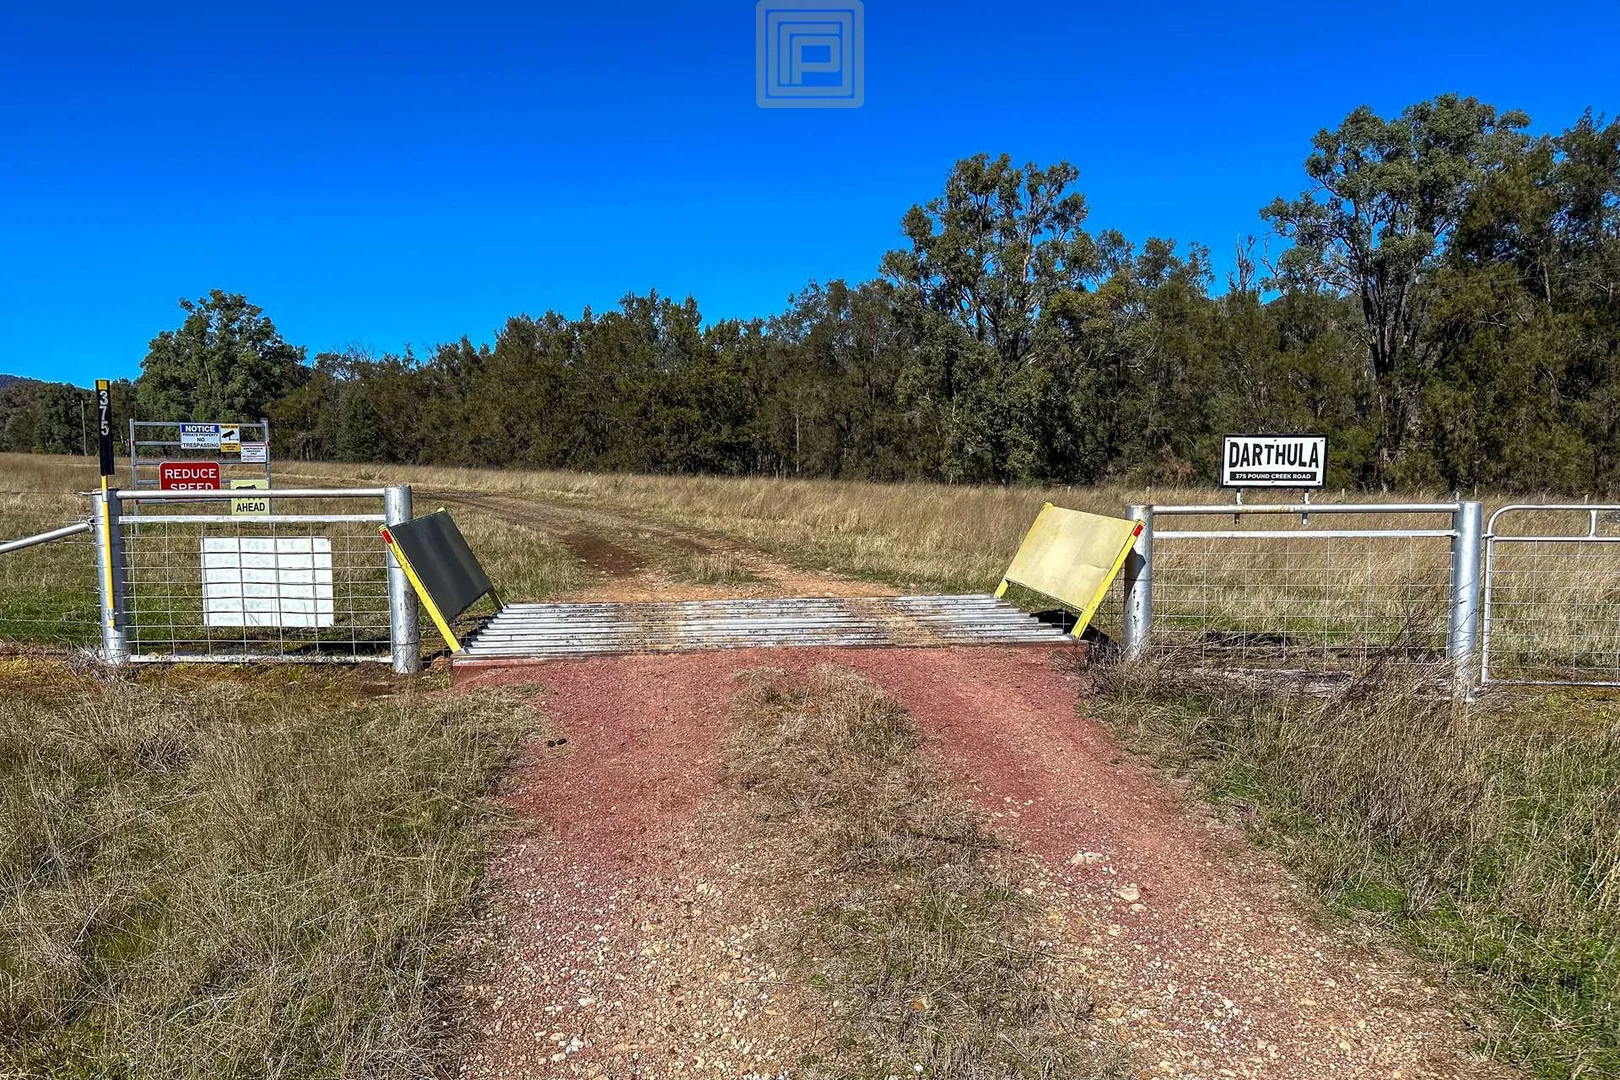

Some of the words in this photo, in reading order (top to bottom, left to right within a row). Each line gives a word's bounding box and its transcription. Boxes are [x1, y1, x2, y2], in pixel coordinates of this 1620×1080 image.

[99, 391, 109, 435] 375
[1229, 442, 1319, 468] DARTHULA
[165, 469, 217, 479] REDUCE
[236, 502, 266, 512] AHEAD
